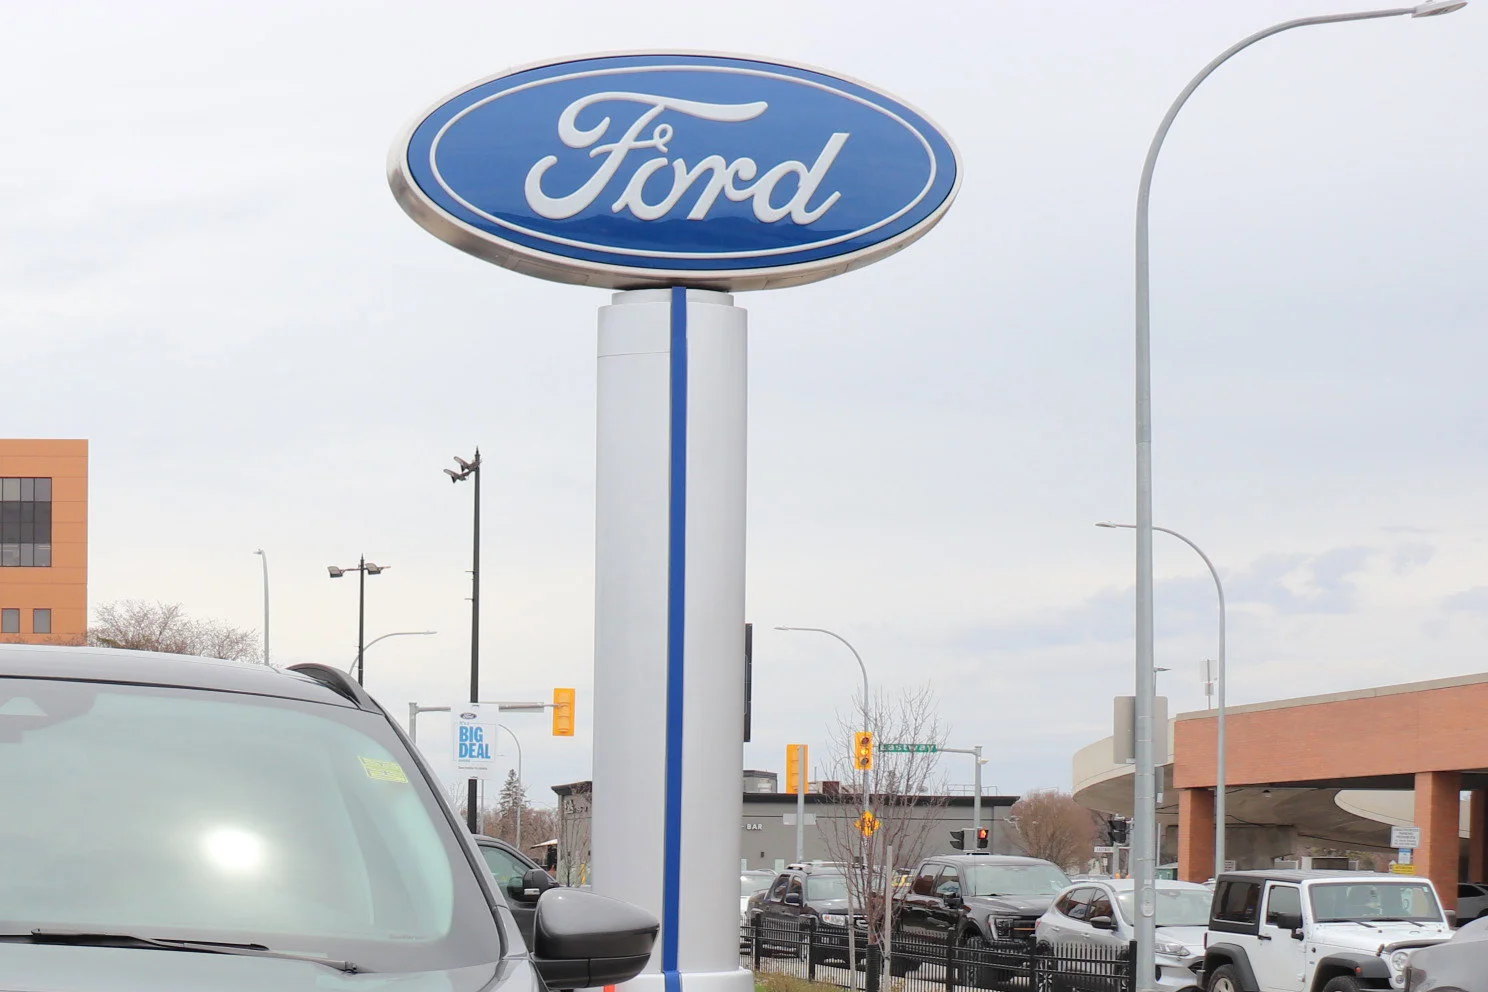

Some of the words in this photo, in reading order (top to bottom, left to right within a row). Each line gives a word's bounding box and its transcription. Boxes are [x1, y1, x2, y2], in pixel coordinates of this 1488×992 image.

[524, 90, 851, 226] Ford
[459, 725, 483, 743] BIG
[458, 742, 491, 759] DEAL
